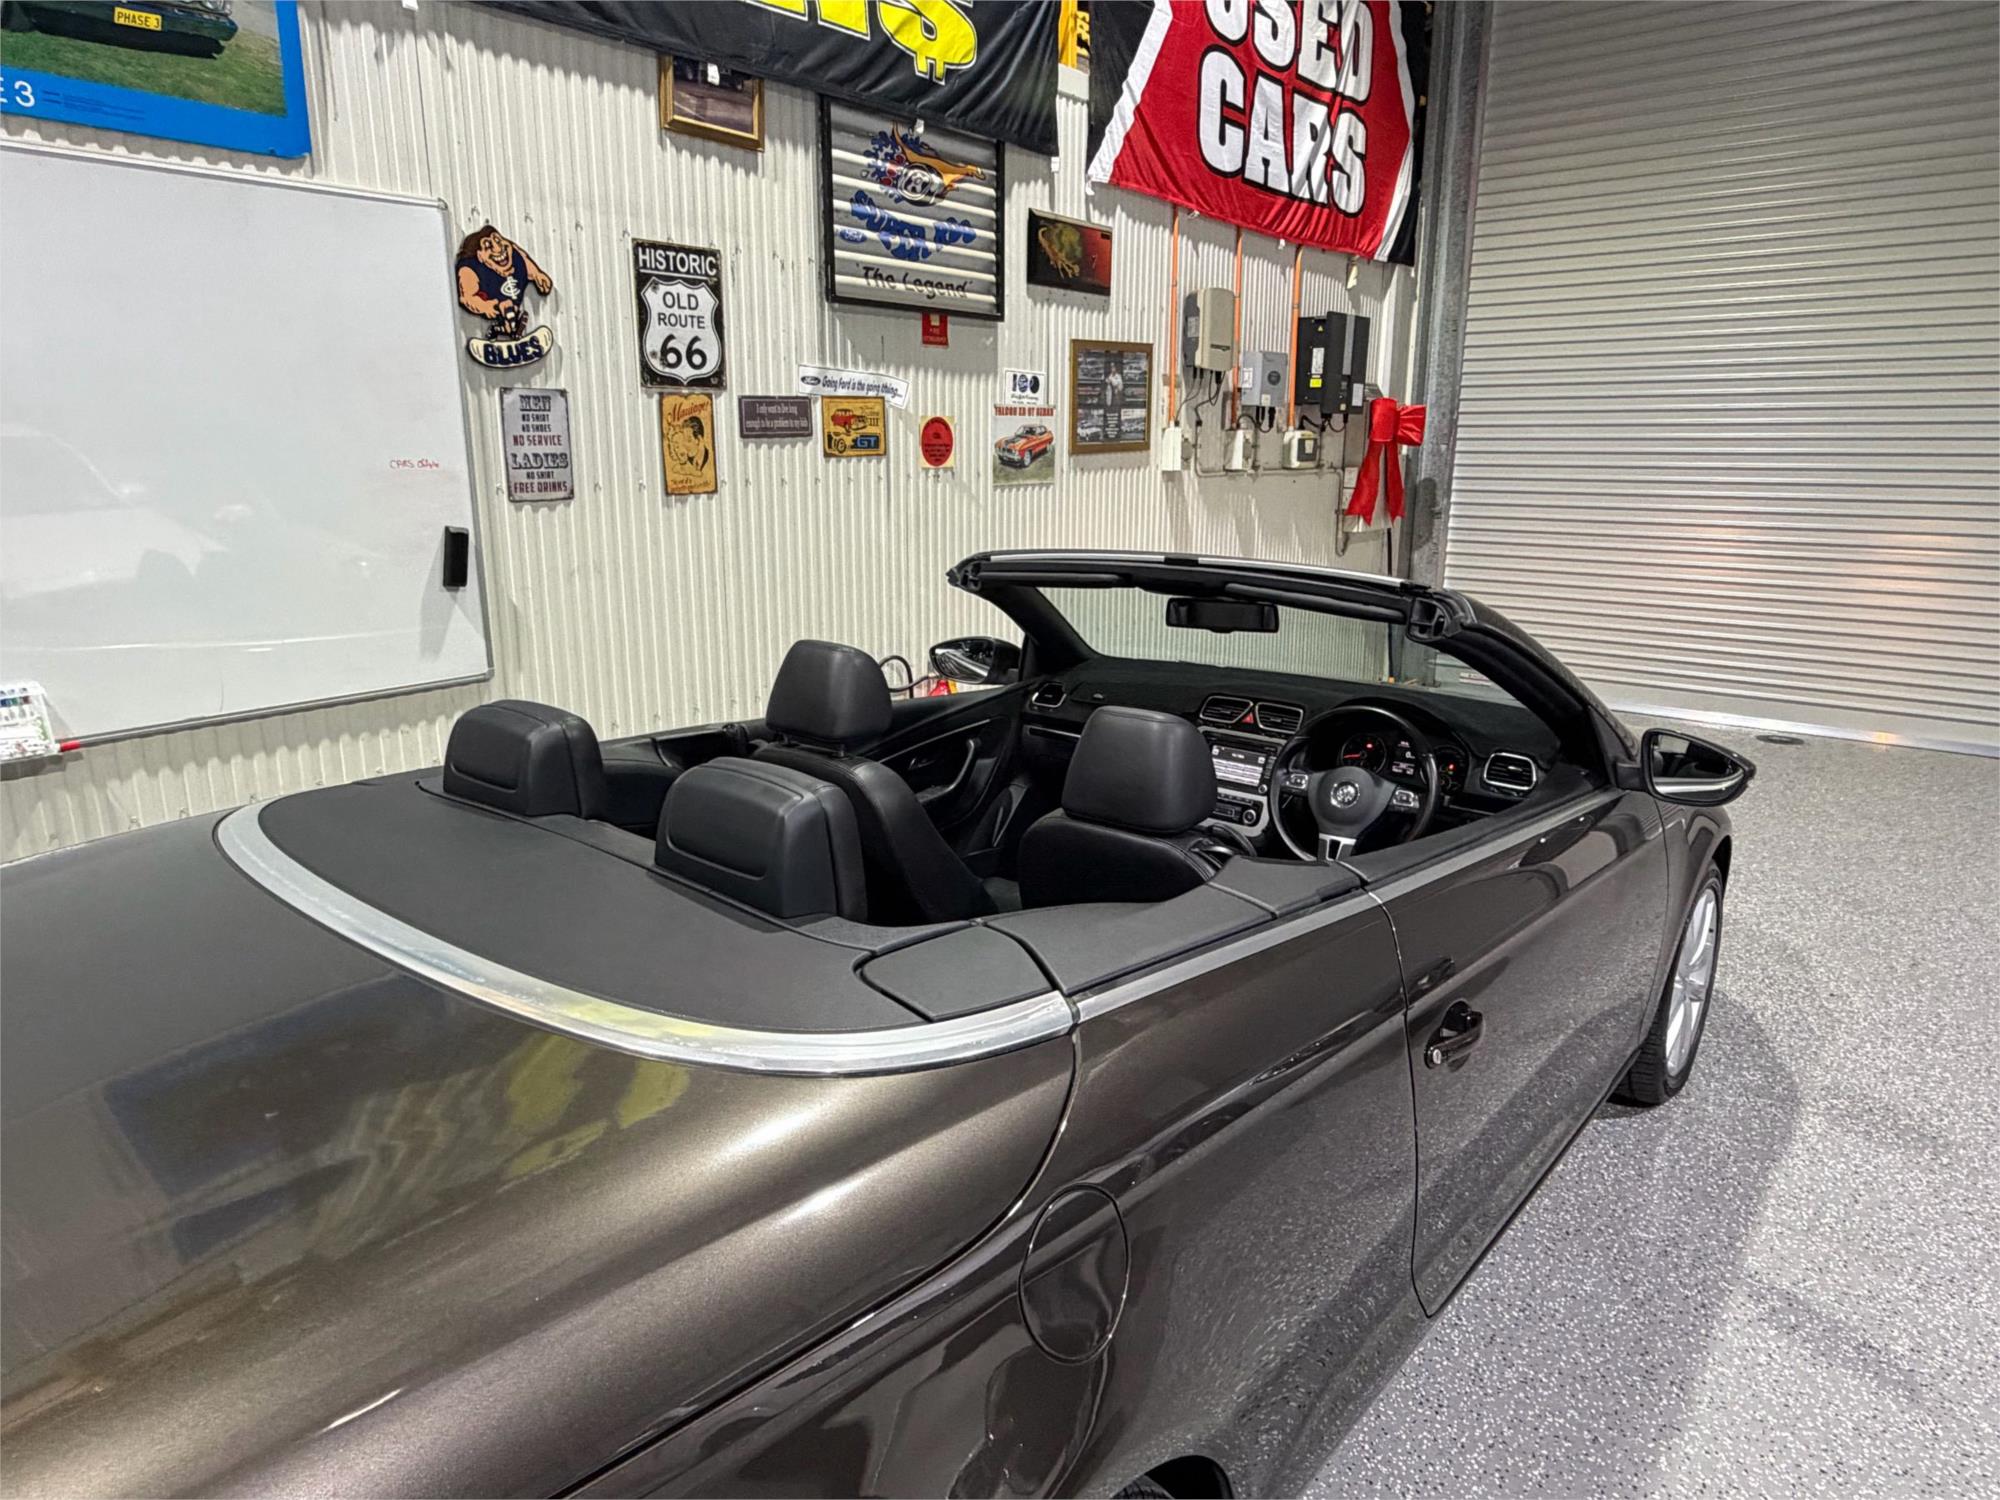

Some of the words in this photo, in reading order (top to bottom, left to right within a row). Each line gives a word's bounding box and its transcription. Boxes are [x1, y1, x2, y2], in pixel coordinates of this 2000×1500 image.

[116, 11, 151, 28] PHASE
[153, 17, 161, 29] 3
[14, 80, 36, 108] 3
[1199, 49, 1367, 216] CARS
[638, 246, 718, 277] HISTORIC
[662, 291, 699, 311] OLD
[657, 312, 706, 330] ROUTE
[483, 335, 544, 366] BLUES
[660, 333, 708, 371] 66
[822, 375, 838, 392] Going
[838, 377, 850, 391] Ford
[857, 380, 866, 392] the
[866, 382, 881, 396] going
[519, 394, 551, 412] MEN
[522, 413, 530, 422] NO
[531, 413, 550, 423] SHIRT
[522, 424, 531, 433] NO
[531, 424, 552, 433] SHOES
[512, 434, 525, 446] NO
[527, 434, 563, 446] SERVICE
[856, 436, 878, 448] GT
[510, 452, 569, 470] LADIES
[526, 471, 535, 480] NO
[536, 471, 554, 480] SHIRT
[513, 481, 535, 494] FREE
[537, 481, 568, 493] DRINKS
